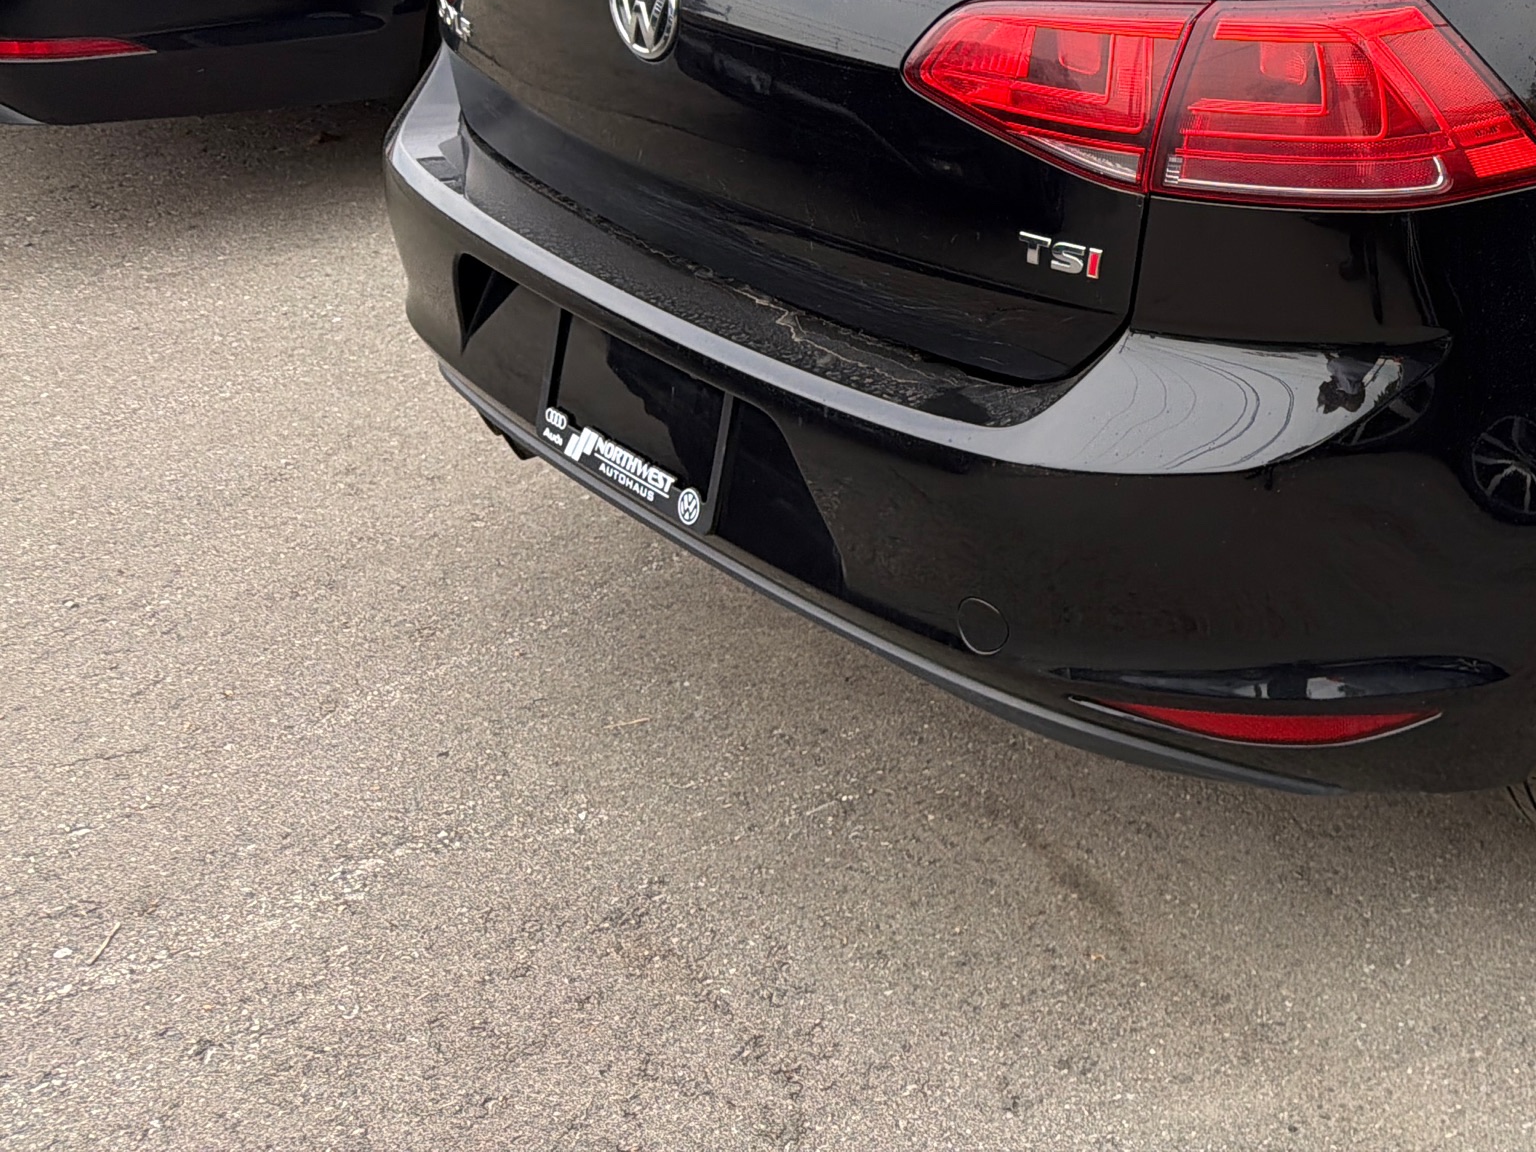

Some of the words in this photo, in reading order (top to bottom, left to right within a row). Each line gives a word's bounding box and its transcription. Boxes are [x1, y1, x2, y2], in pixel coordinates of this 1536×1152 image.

[1019, 231, 1103, 279] TSI
[595, 436, 678, 493] NORTHWEST
[598, 464, 655, 502] AUTOHAUS
